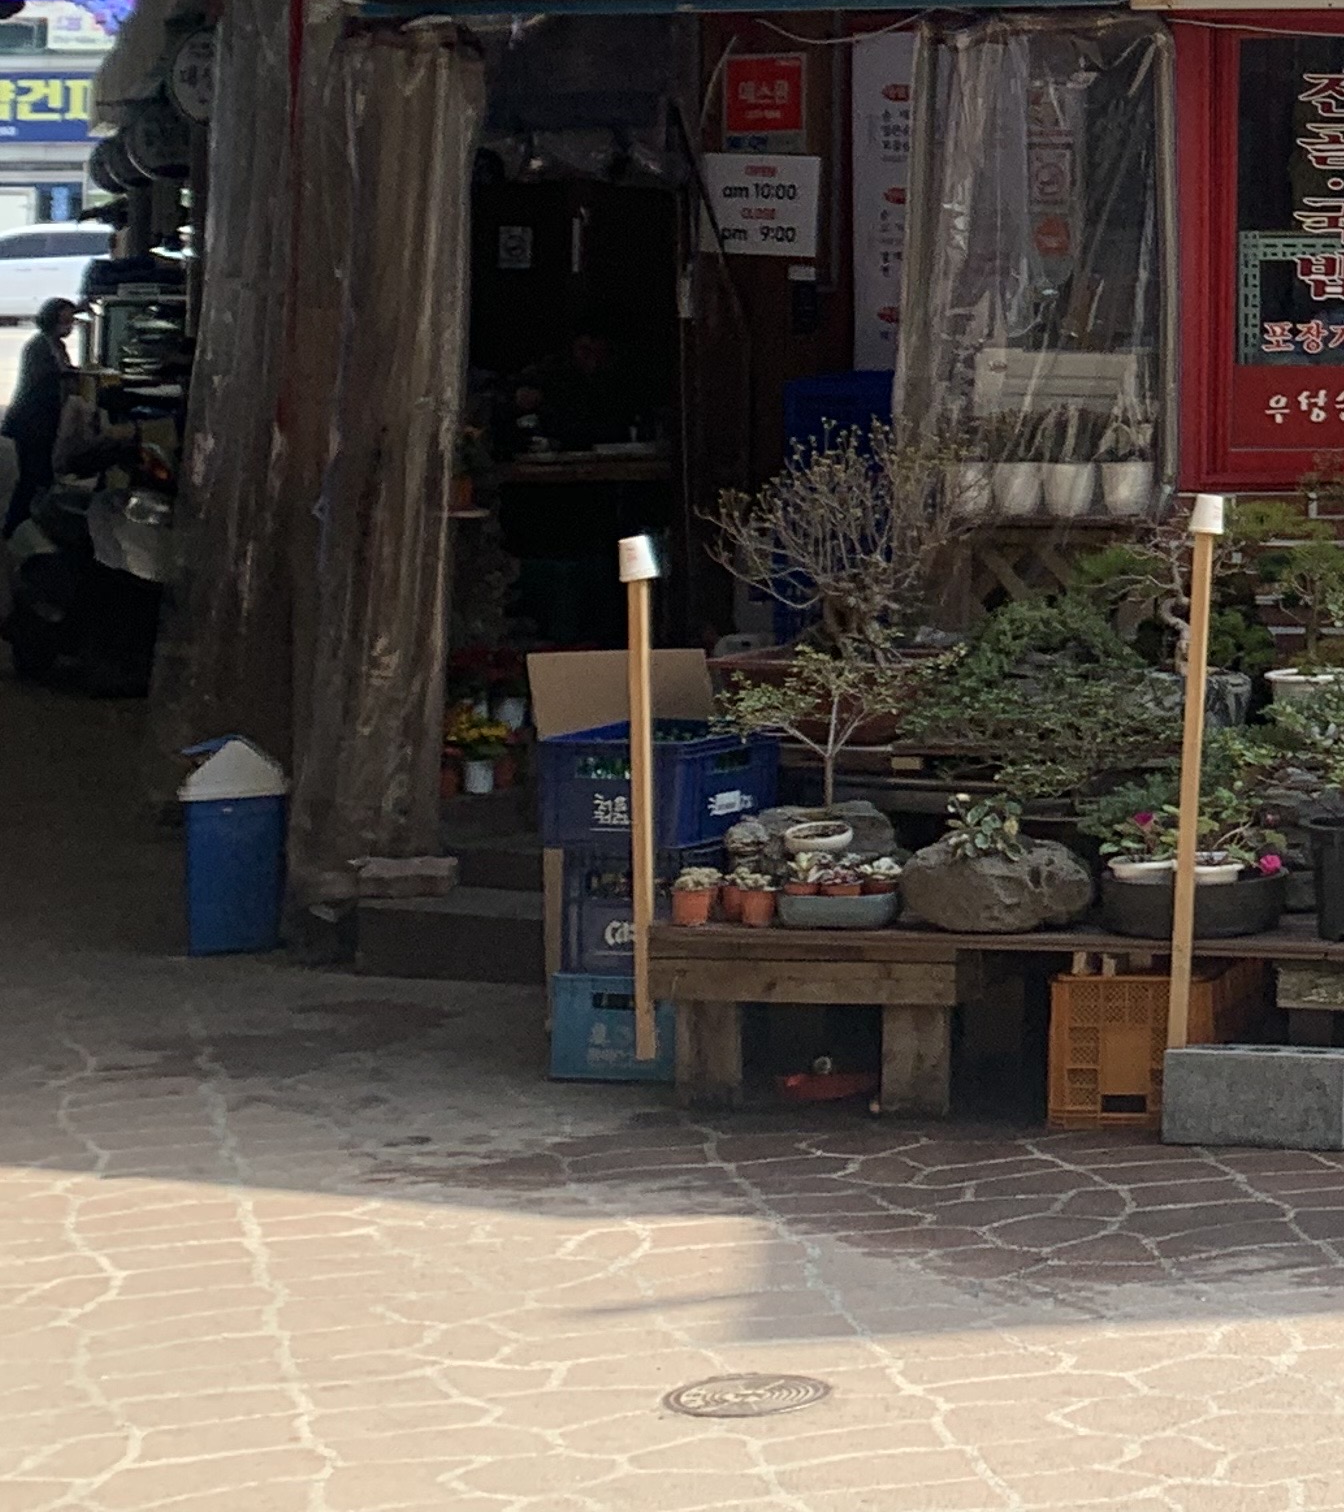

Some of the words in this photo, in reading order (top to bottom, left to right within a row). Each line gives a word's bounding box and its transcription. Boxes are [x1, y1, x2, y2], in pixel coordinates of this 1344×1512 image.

[723, 184, 749, 200] am
[753, 182, 798, 201] 10:00
[759, 225, 797, 243] 9:00
